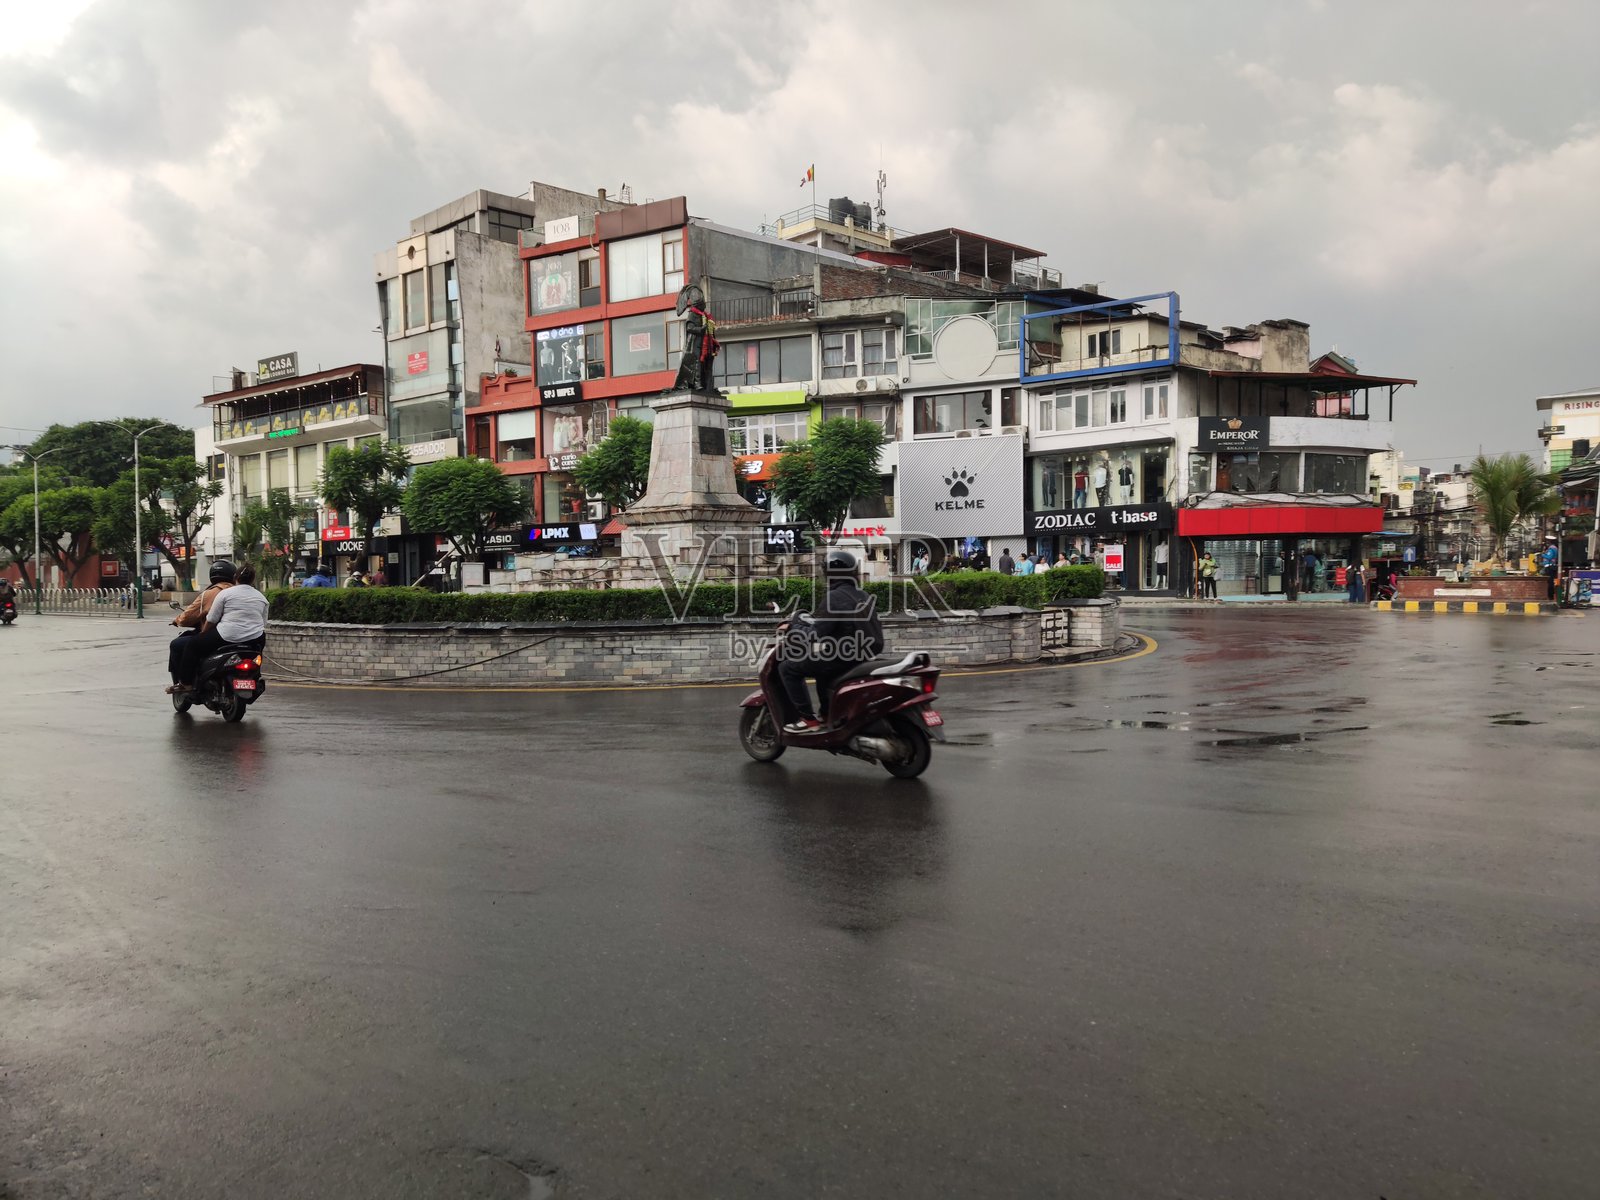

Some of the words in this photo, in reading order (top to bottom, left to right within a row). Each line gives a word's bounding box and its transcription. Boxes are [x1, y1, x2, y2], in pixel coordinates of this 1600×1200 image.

[269, 357, 293, 371] CASA
[1564, 401, 1600, 410] RISING
[1209, 429, 1260, 441] EMPEROR
[935, 499, 985, 511] KELME
[1034, 512, 1096, 529] ZODIAC
[1110, 510, 1158, 524] t-base
[766, 528, 795, 545] Lee
[337, 541, 366, 552] JOCKE
